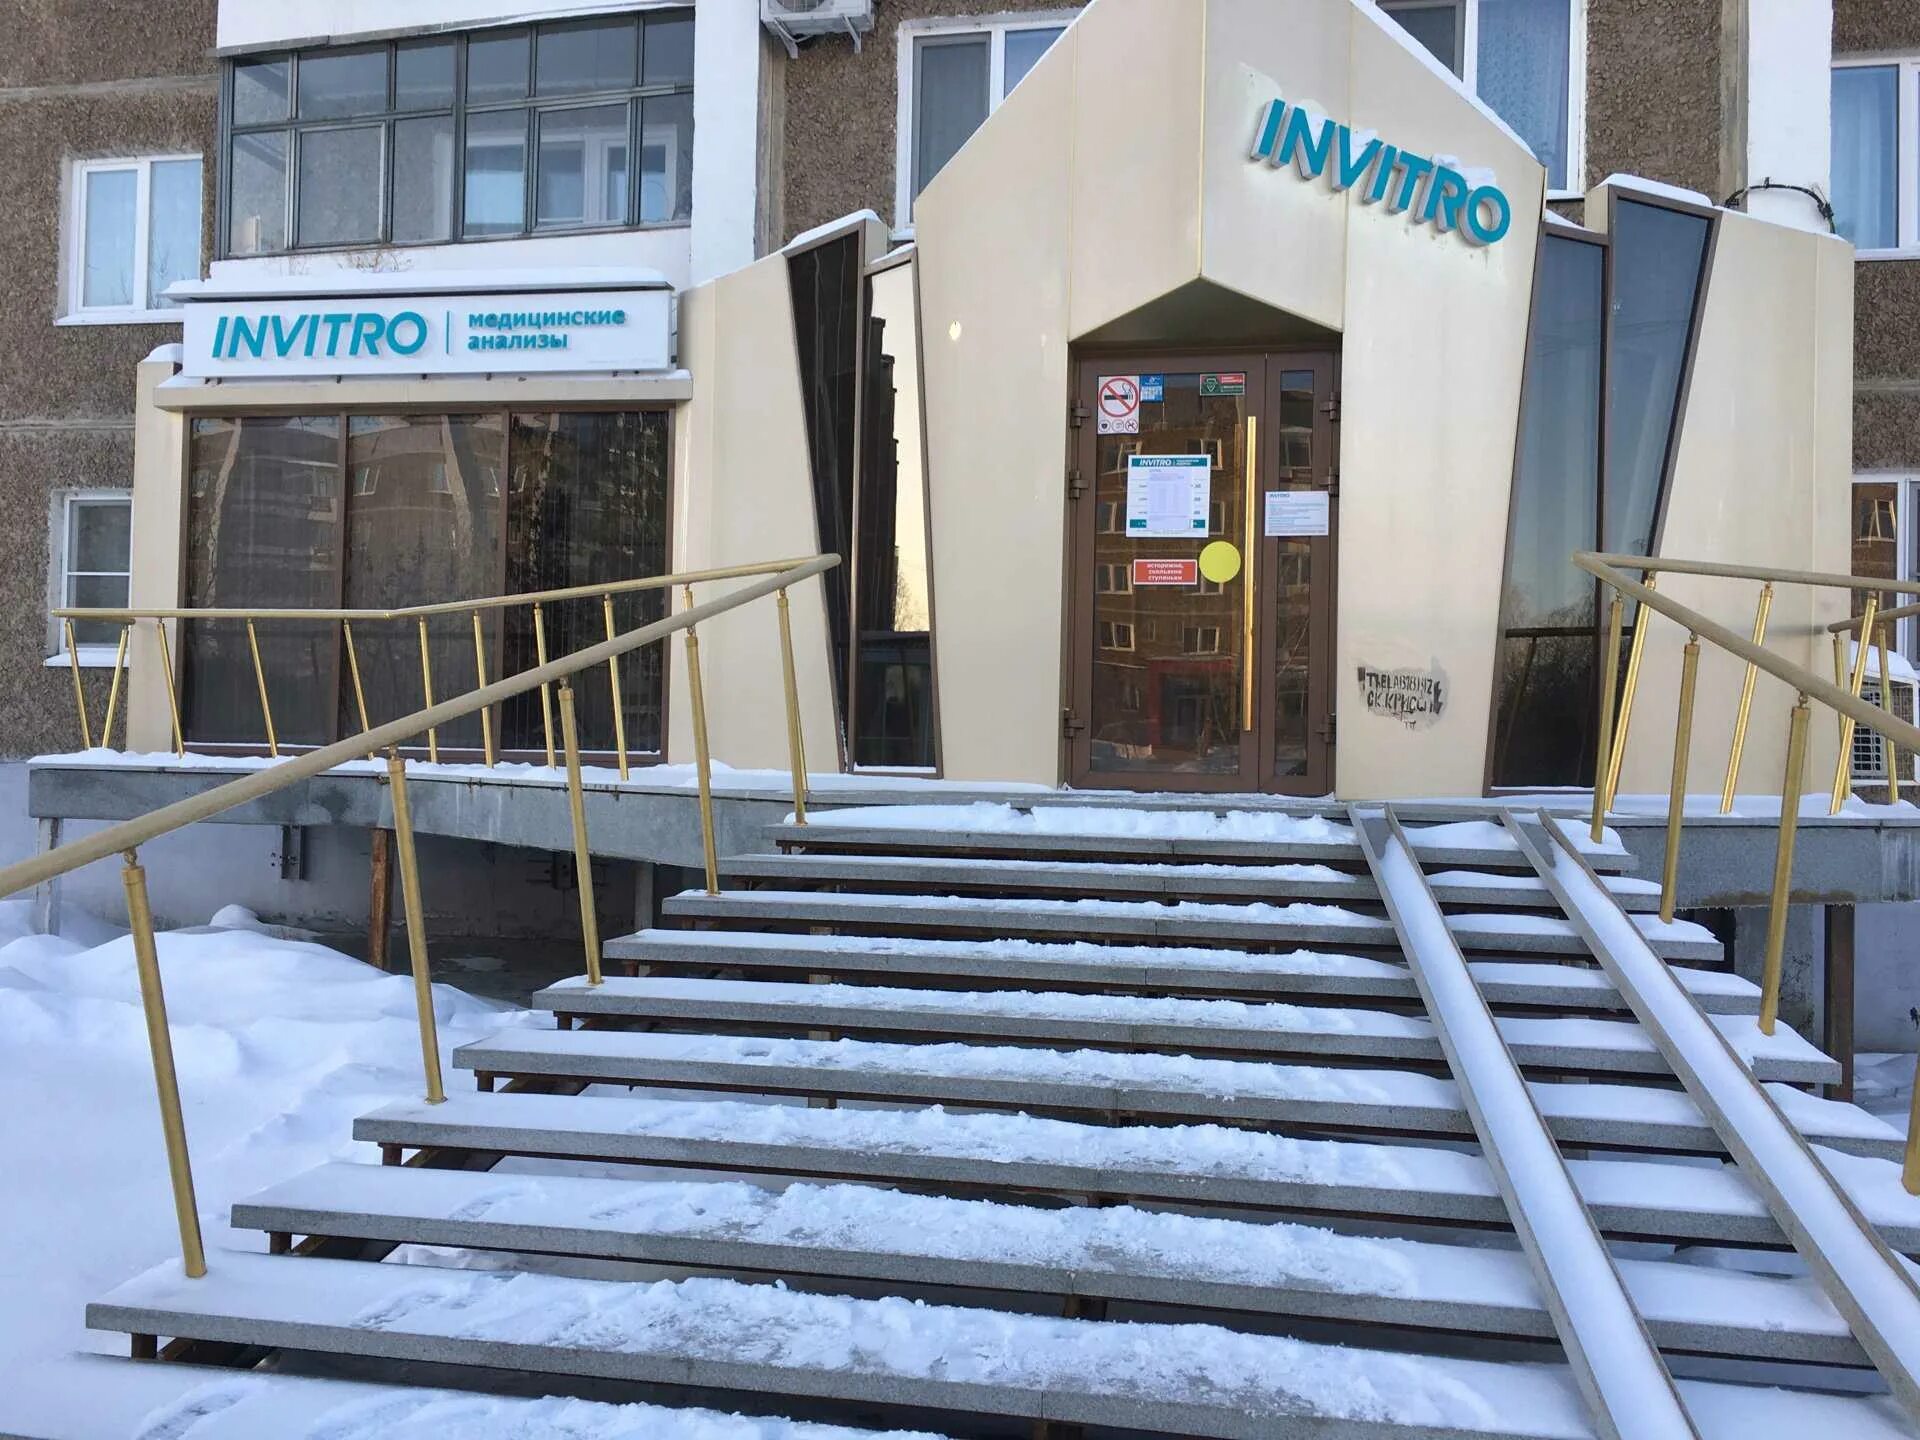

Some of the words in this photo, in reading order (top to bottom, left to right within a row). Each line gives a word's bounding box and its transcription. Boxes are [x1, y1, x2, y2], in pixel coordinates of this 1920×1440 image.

[1252, 98, 1511, 245] INVITRO
[212, 311, 428, 358] INVITRO
[468, 309, 626, 330] медицинские
[467, 333, 568, 351] анализы
